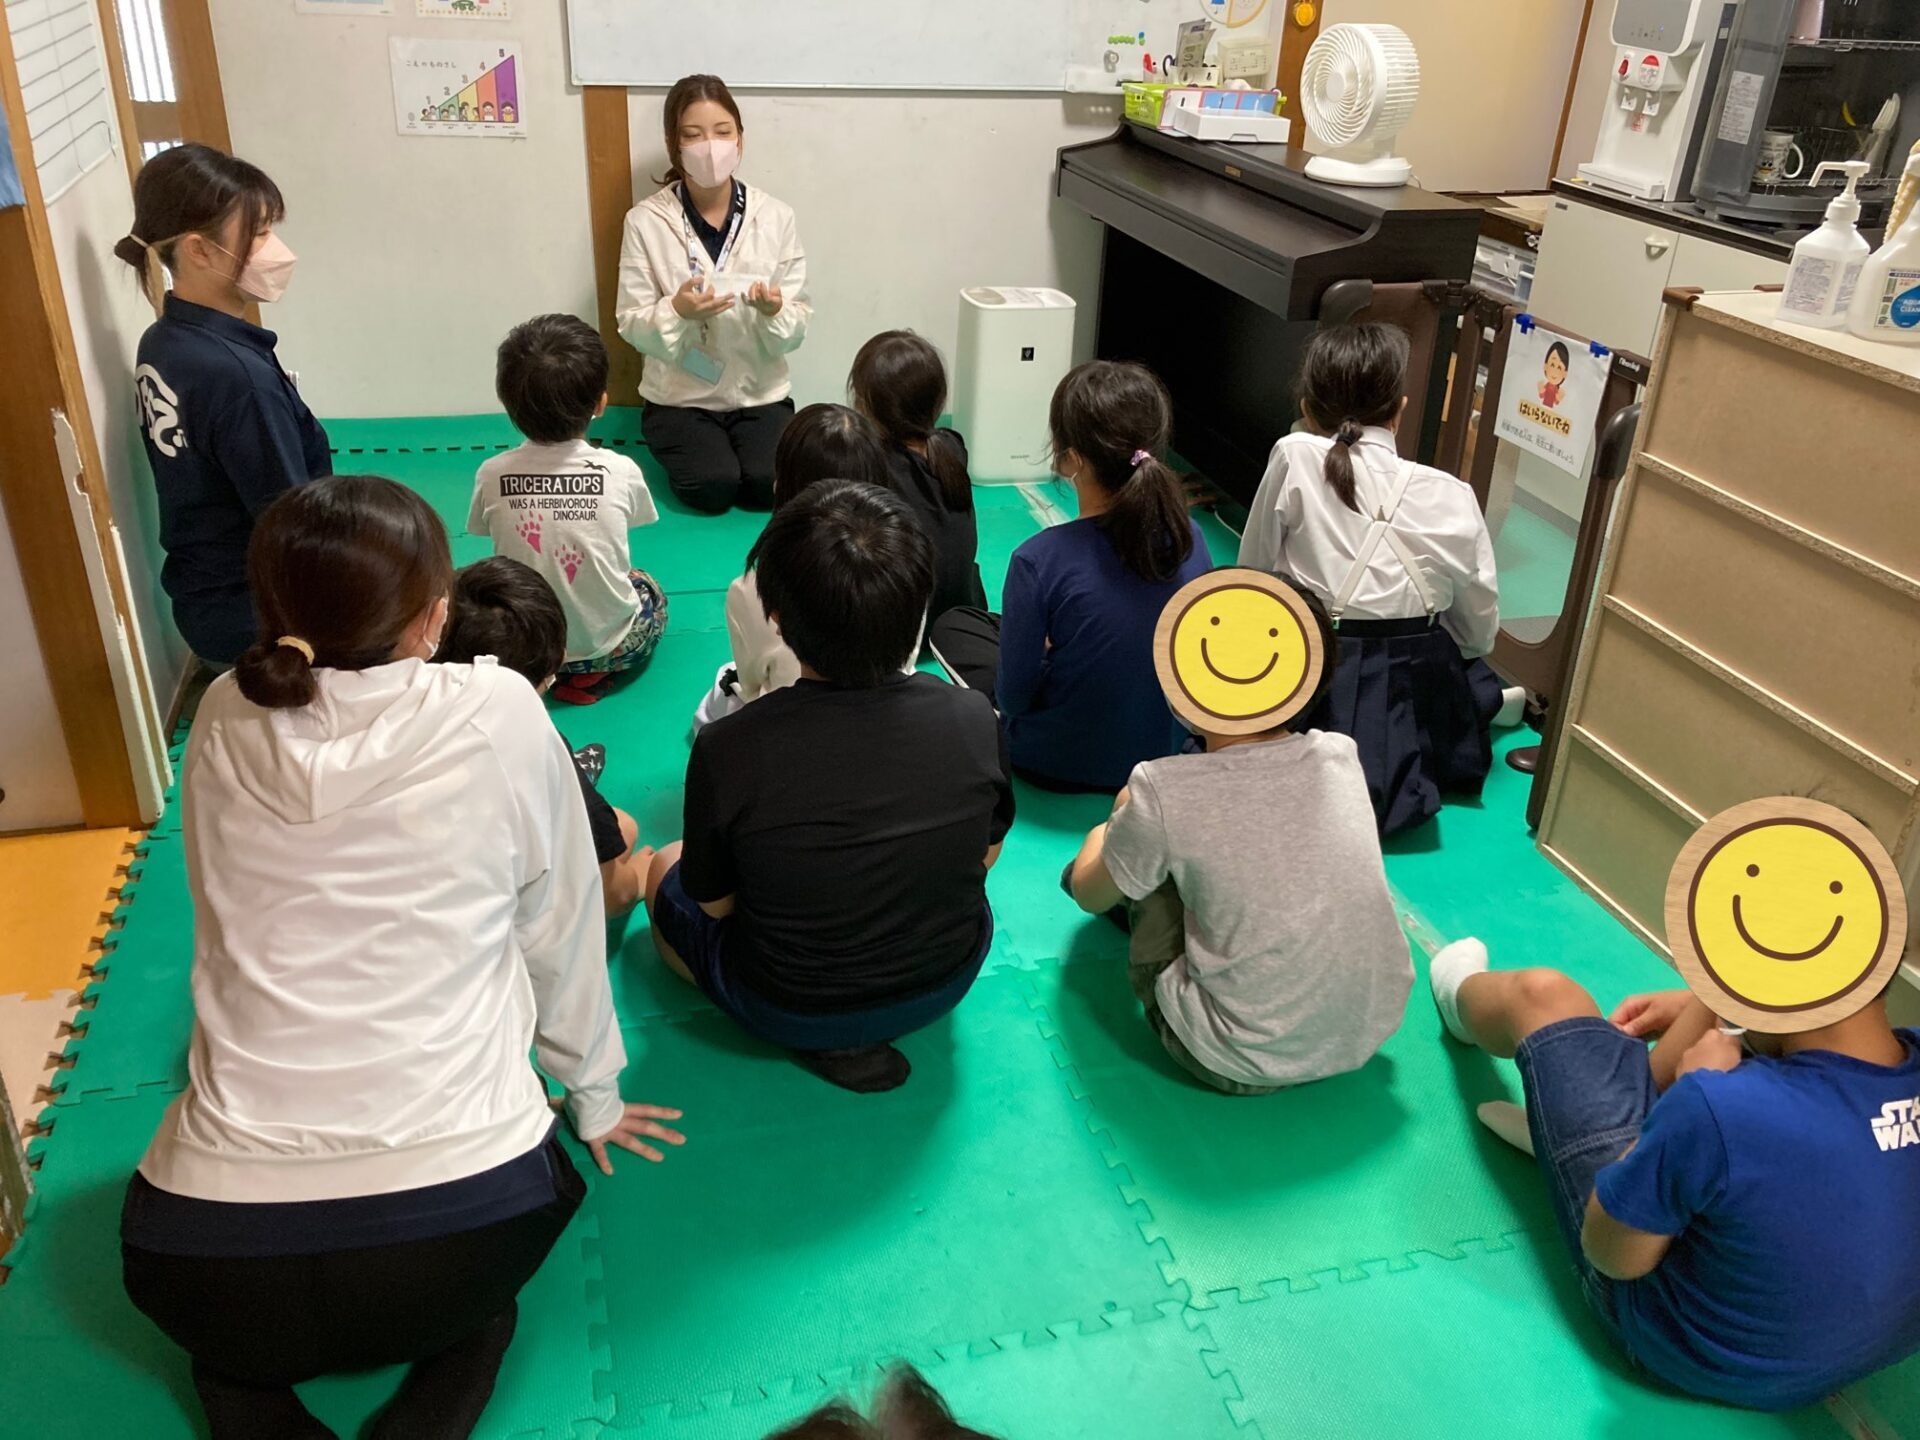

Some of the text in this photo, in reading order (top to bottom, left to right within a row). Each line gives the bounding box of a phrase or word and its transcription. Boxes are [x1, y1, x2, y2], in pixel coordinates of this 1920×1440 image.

[498, 48, 505, 58] 5
[406, 60, 457, 69] こえのものさし
[479, 61, 486, 71] 4
[461, 74, 469, 84] 3
[443, 86, 451, 96] 2
[425, 96, 432, 105] 1
[1519, 402, 1570, 435] はいらないでね
[502, 476, 601, 494] TRICERATOPS
[509, 498, 598, 510] WAS A HERBIVOROUS
[553, 510, 598, 521] DINOSAUR.
[1872, 1120, 1920, 1151] WA
